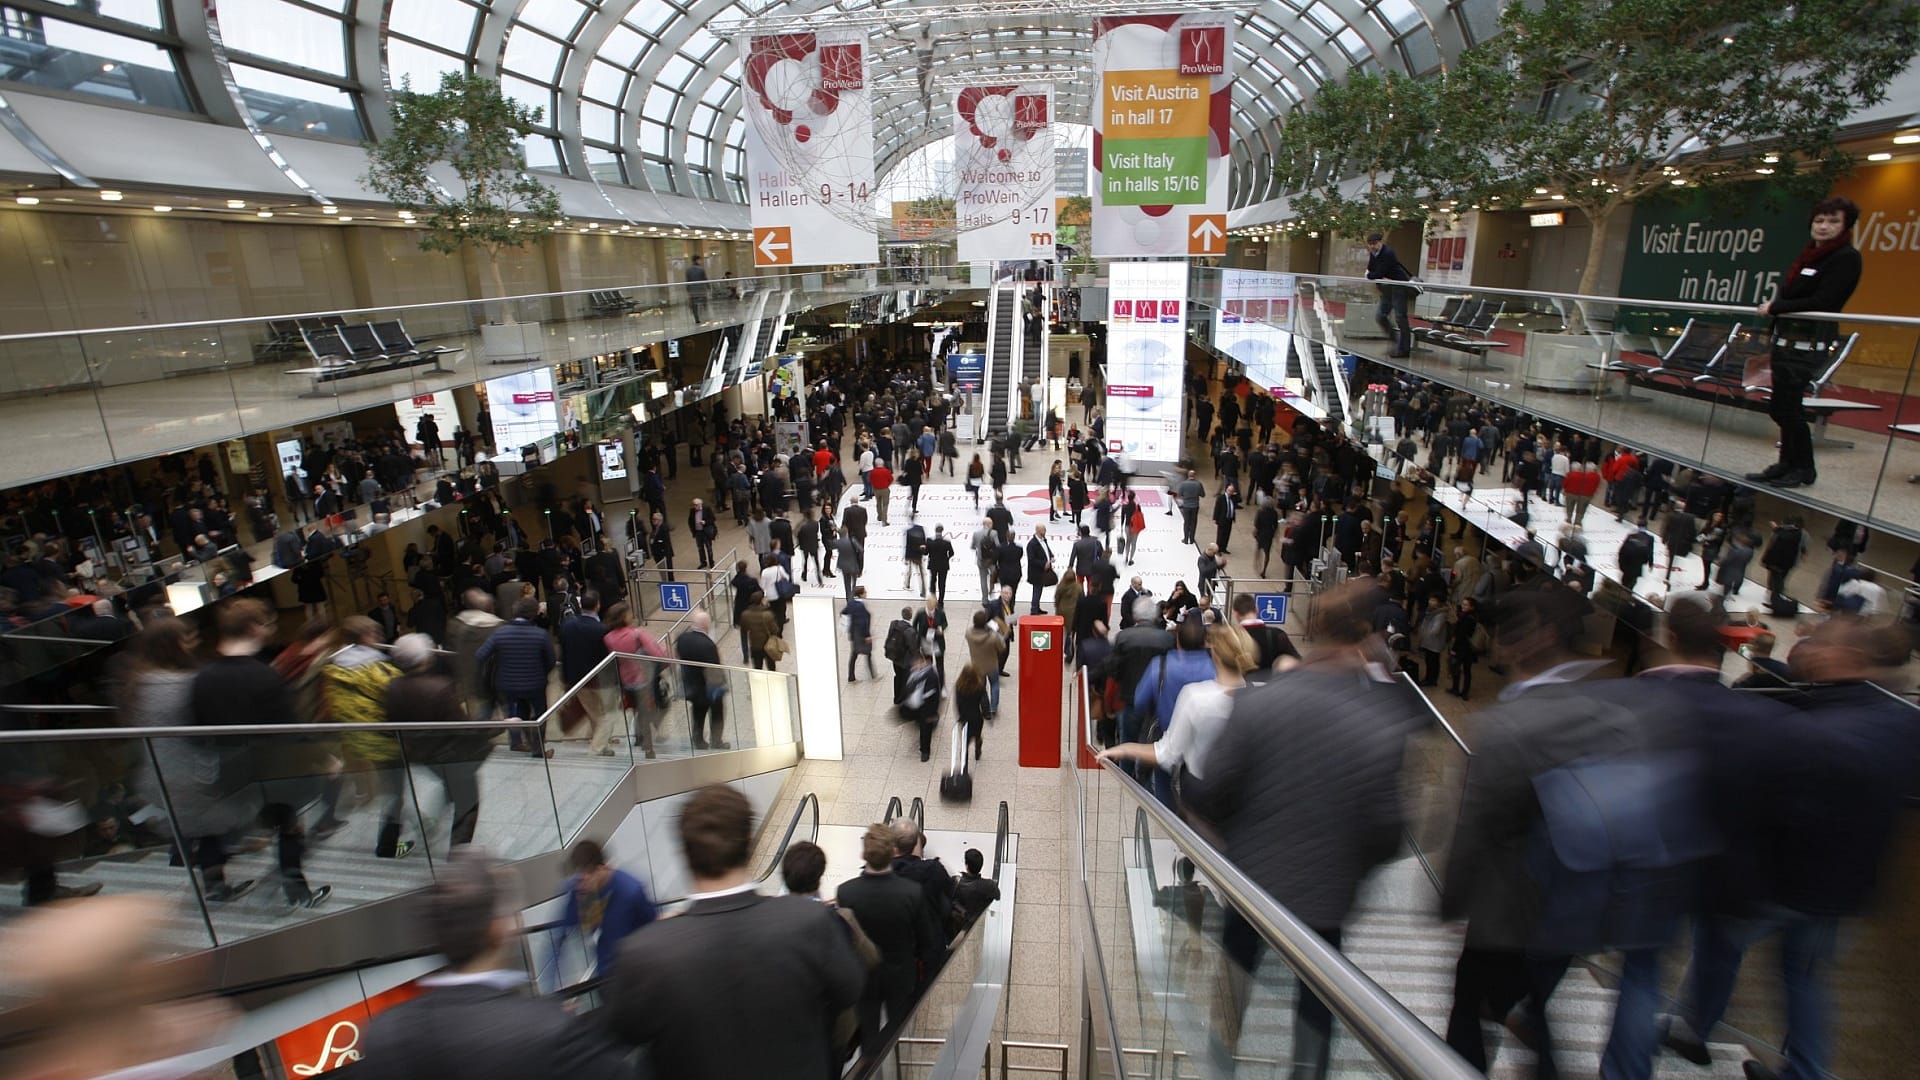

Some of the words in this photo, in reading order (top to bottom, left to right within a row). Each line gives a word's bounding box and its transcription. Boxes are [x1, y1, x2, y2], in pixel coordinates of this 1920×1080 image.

[1181, 64, 1222, 74] ProWein
[1112, 84, 1143, 101] Visit
[1145, 82, 1199, 100] Austria
[1111, 109, 1124, 125] in
[1128, 108, 1154, 125] hall
[1159, 108, 1173, 124] 17
[1109, 153, 1141, 169] Visit
[1143, 152, 1175, 172] Italy
[962, 169, 1025, 184] Welcome
[1109, 176, 1124, 192] in
[1125, 175, 1159, 192] halls
[1163, 175, 1200, 192] 15/16
[760, 191, 808, 208] Hallen
[963, 189, 1019, 205] ProWein
[963, 213, 993, 227] Halls
[1642, 223, 1682, 254] Visit
[1684, 222, 1765, 261] Europe
[1679, 269, 1698, 300] in
[1702, 270, 1747, 303] hall
[1752, 271, 1781, 304] 15
